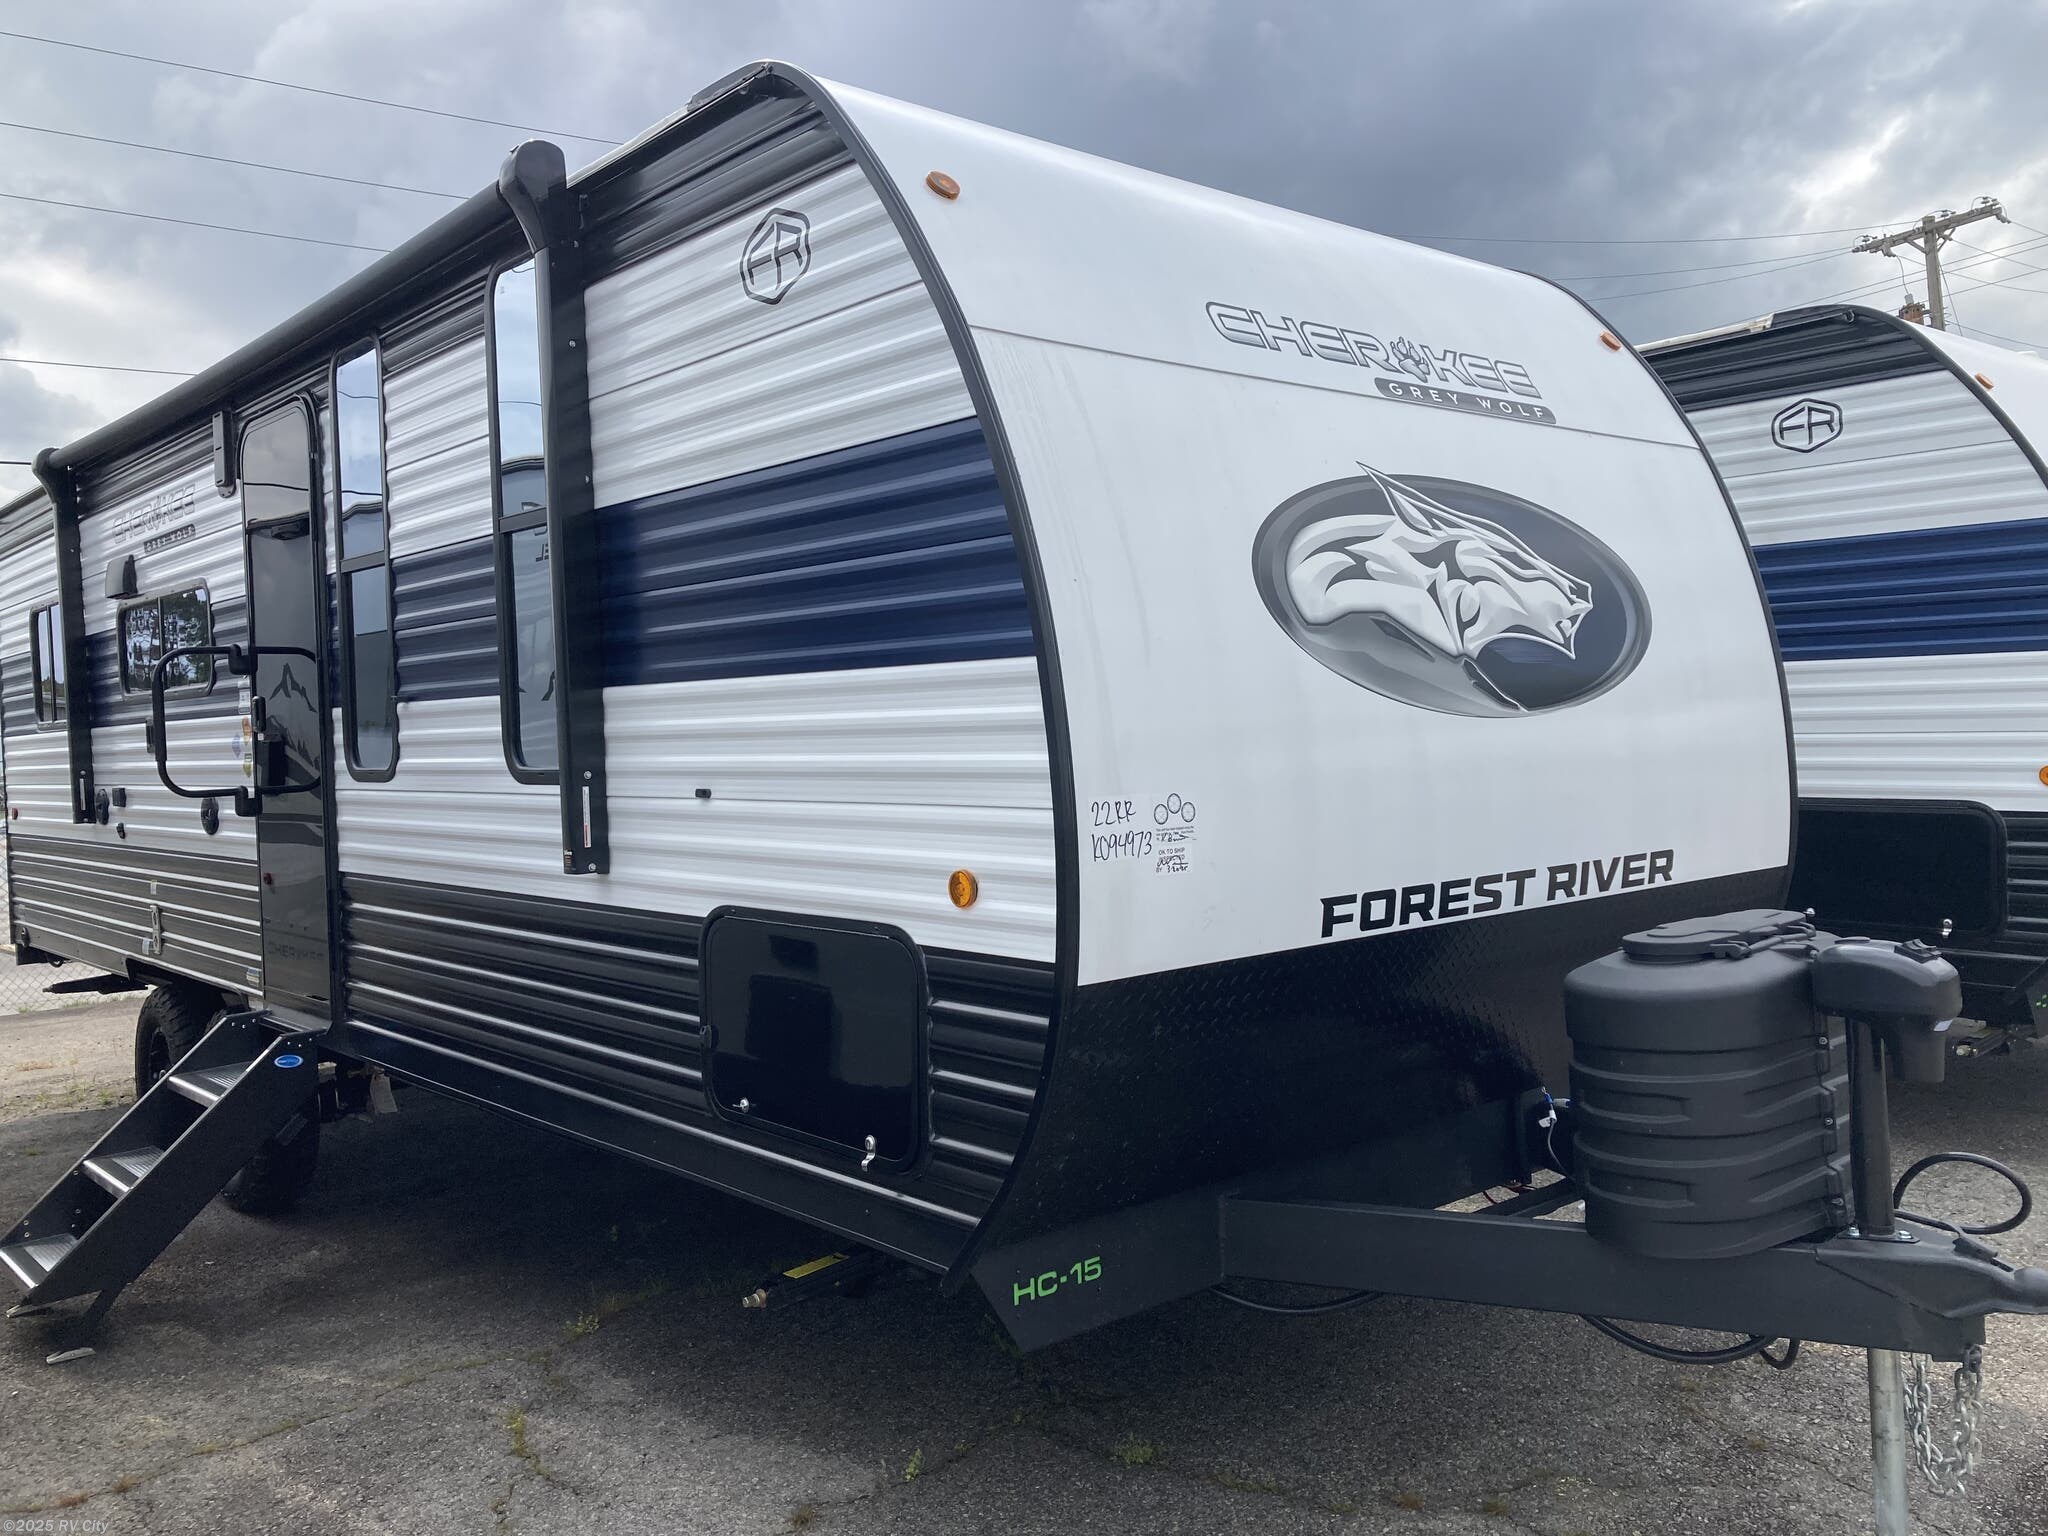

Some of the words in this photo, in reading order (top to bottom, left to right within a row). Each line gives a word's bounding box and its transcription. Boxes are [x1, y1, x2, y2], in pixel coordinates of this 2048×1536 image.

[1206, 301, 1542, 399] CHEROKEE
[1388, 381, 1458, 406] GREY
[1476, 395, 1545, 418] WOLF
[1320, 868, 1536, 938] FOREST
[1546, 849, 1674, 901] RIVER
[1013, 1256, 1102, 1306] HC-15
